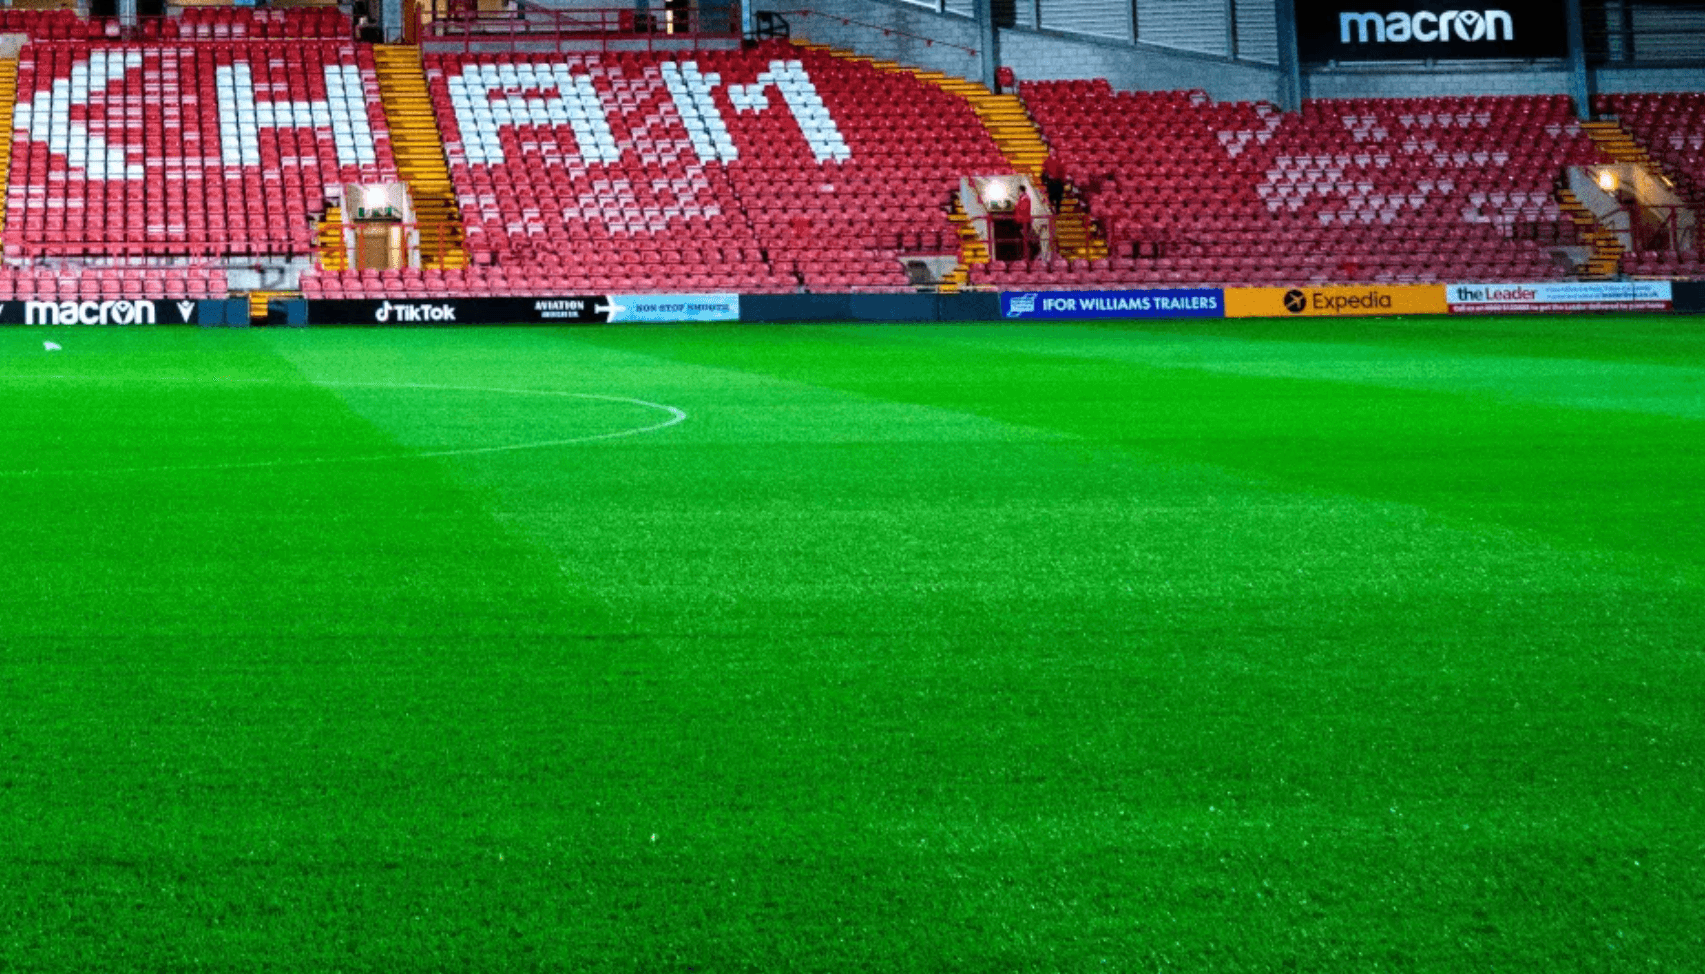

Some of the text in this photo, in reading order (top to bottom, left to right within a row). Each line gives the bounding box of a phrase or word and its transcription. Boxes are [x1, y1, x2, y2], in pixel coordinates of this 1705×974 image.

[1339, 10, 1514, 42] macron
[1313, 293, 1392, 311] Expedia
[1457, 287, 1483, 301] the
[1486, 286, 1537, 301] Leader
[395, 303, 456, 322] TikTok
[534, 301, 584, 311] AVIATION
[1043, 296, 1217, 311] IFOR WILLIAMS TRAILERS
[25, 300, 156, 326] macron
